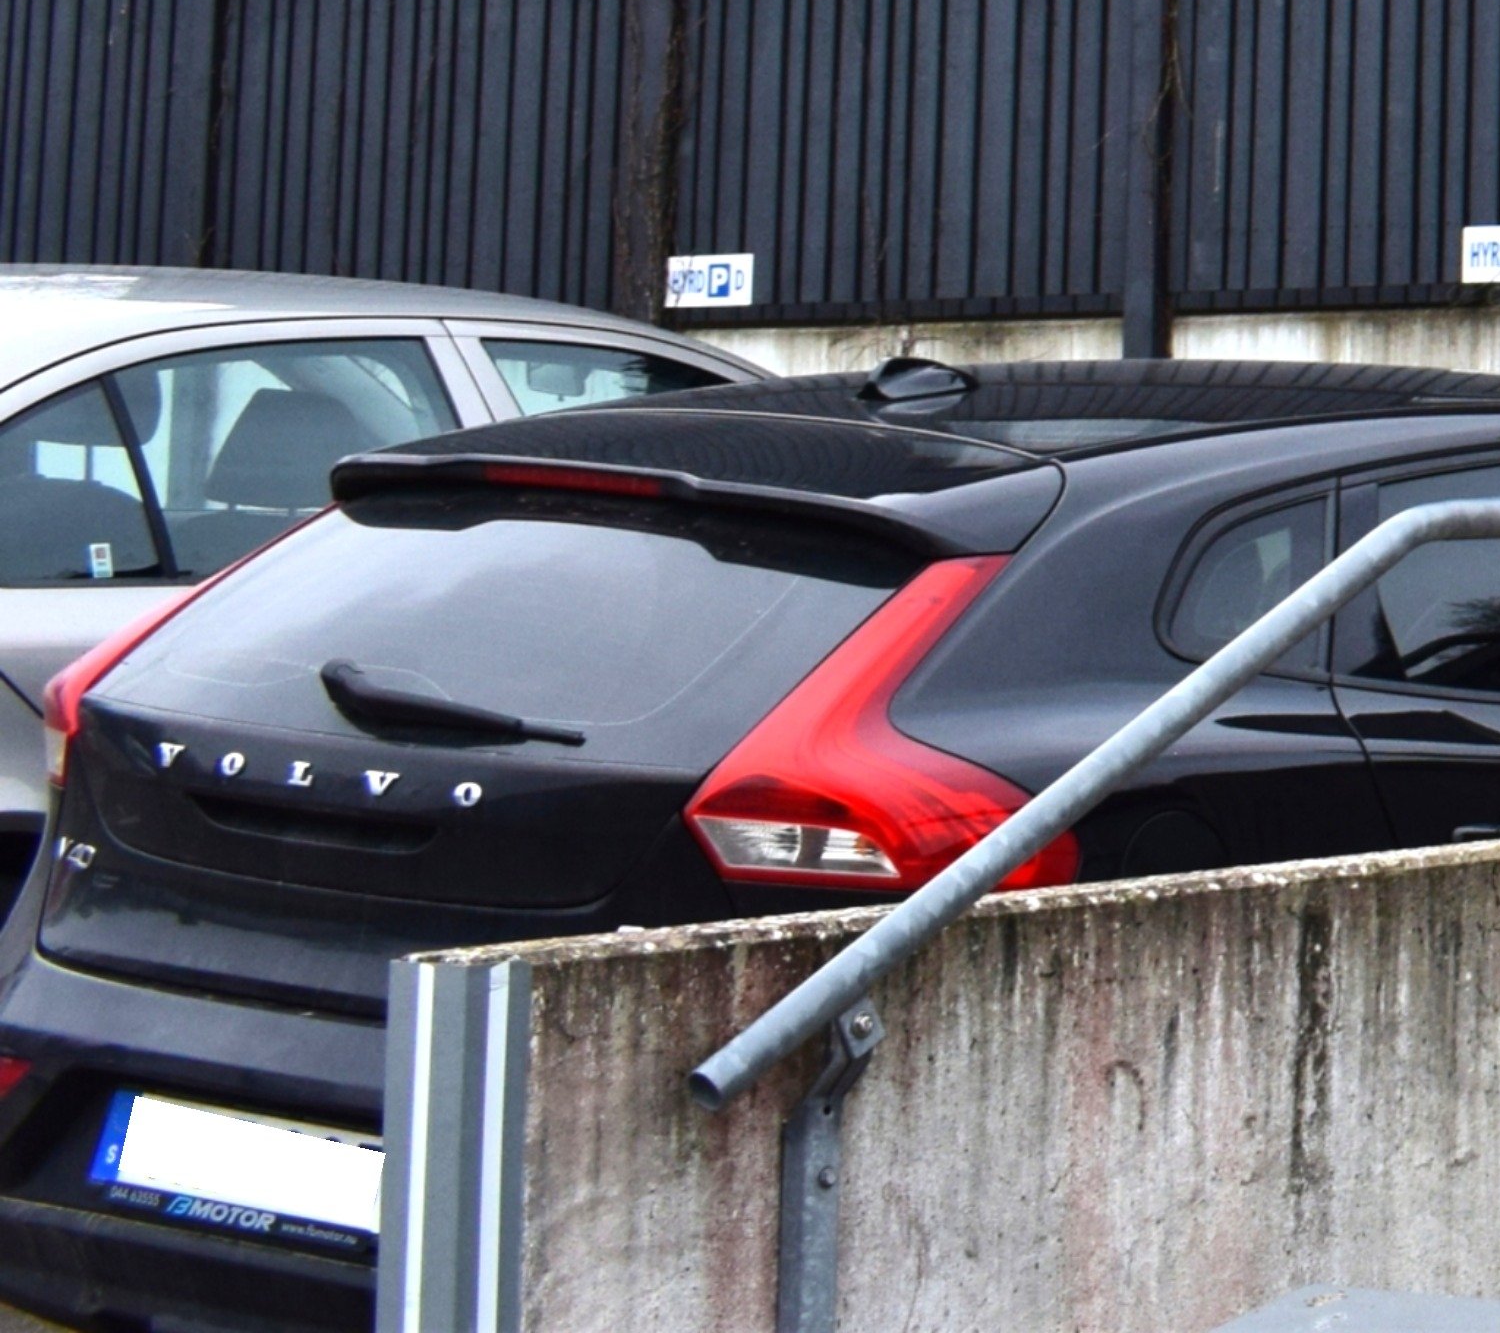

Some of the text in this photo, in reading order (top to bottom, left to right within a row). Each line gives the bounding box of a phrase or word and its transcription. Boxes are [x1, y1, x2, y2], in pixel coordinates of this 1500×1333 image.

[711, 266, 729, 295] P
[735, 269, 745, 291] D
[158, 742, 483, 808] VOLVO
[105, 1144, 119, 1165] S
